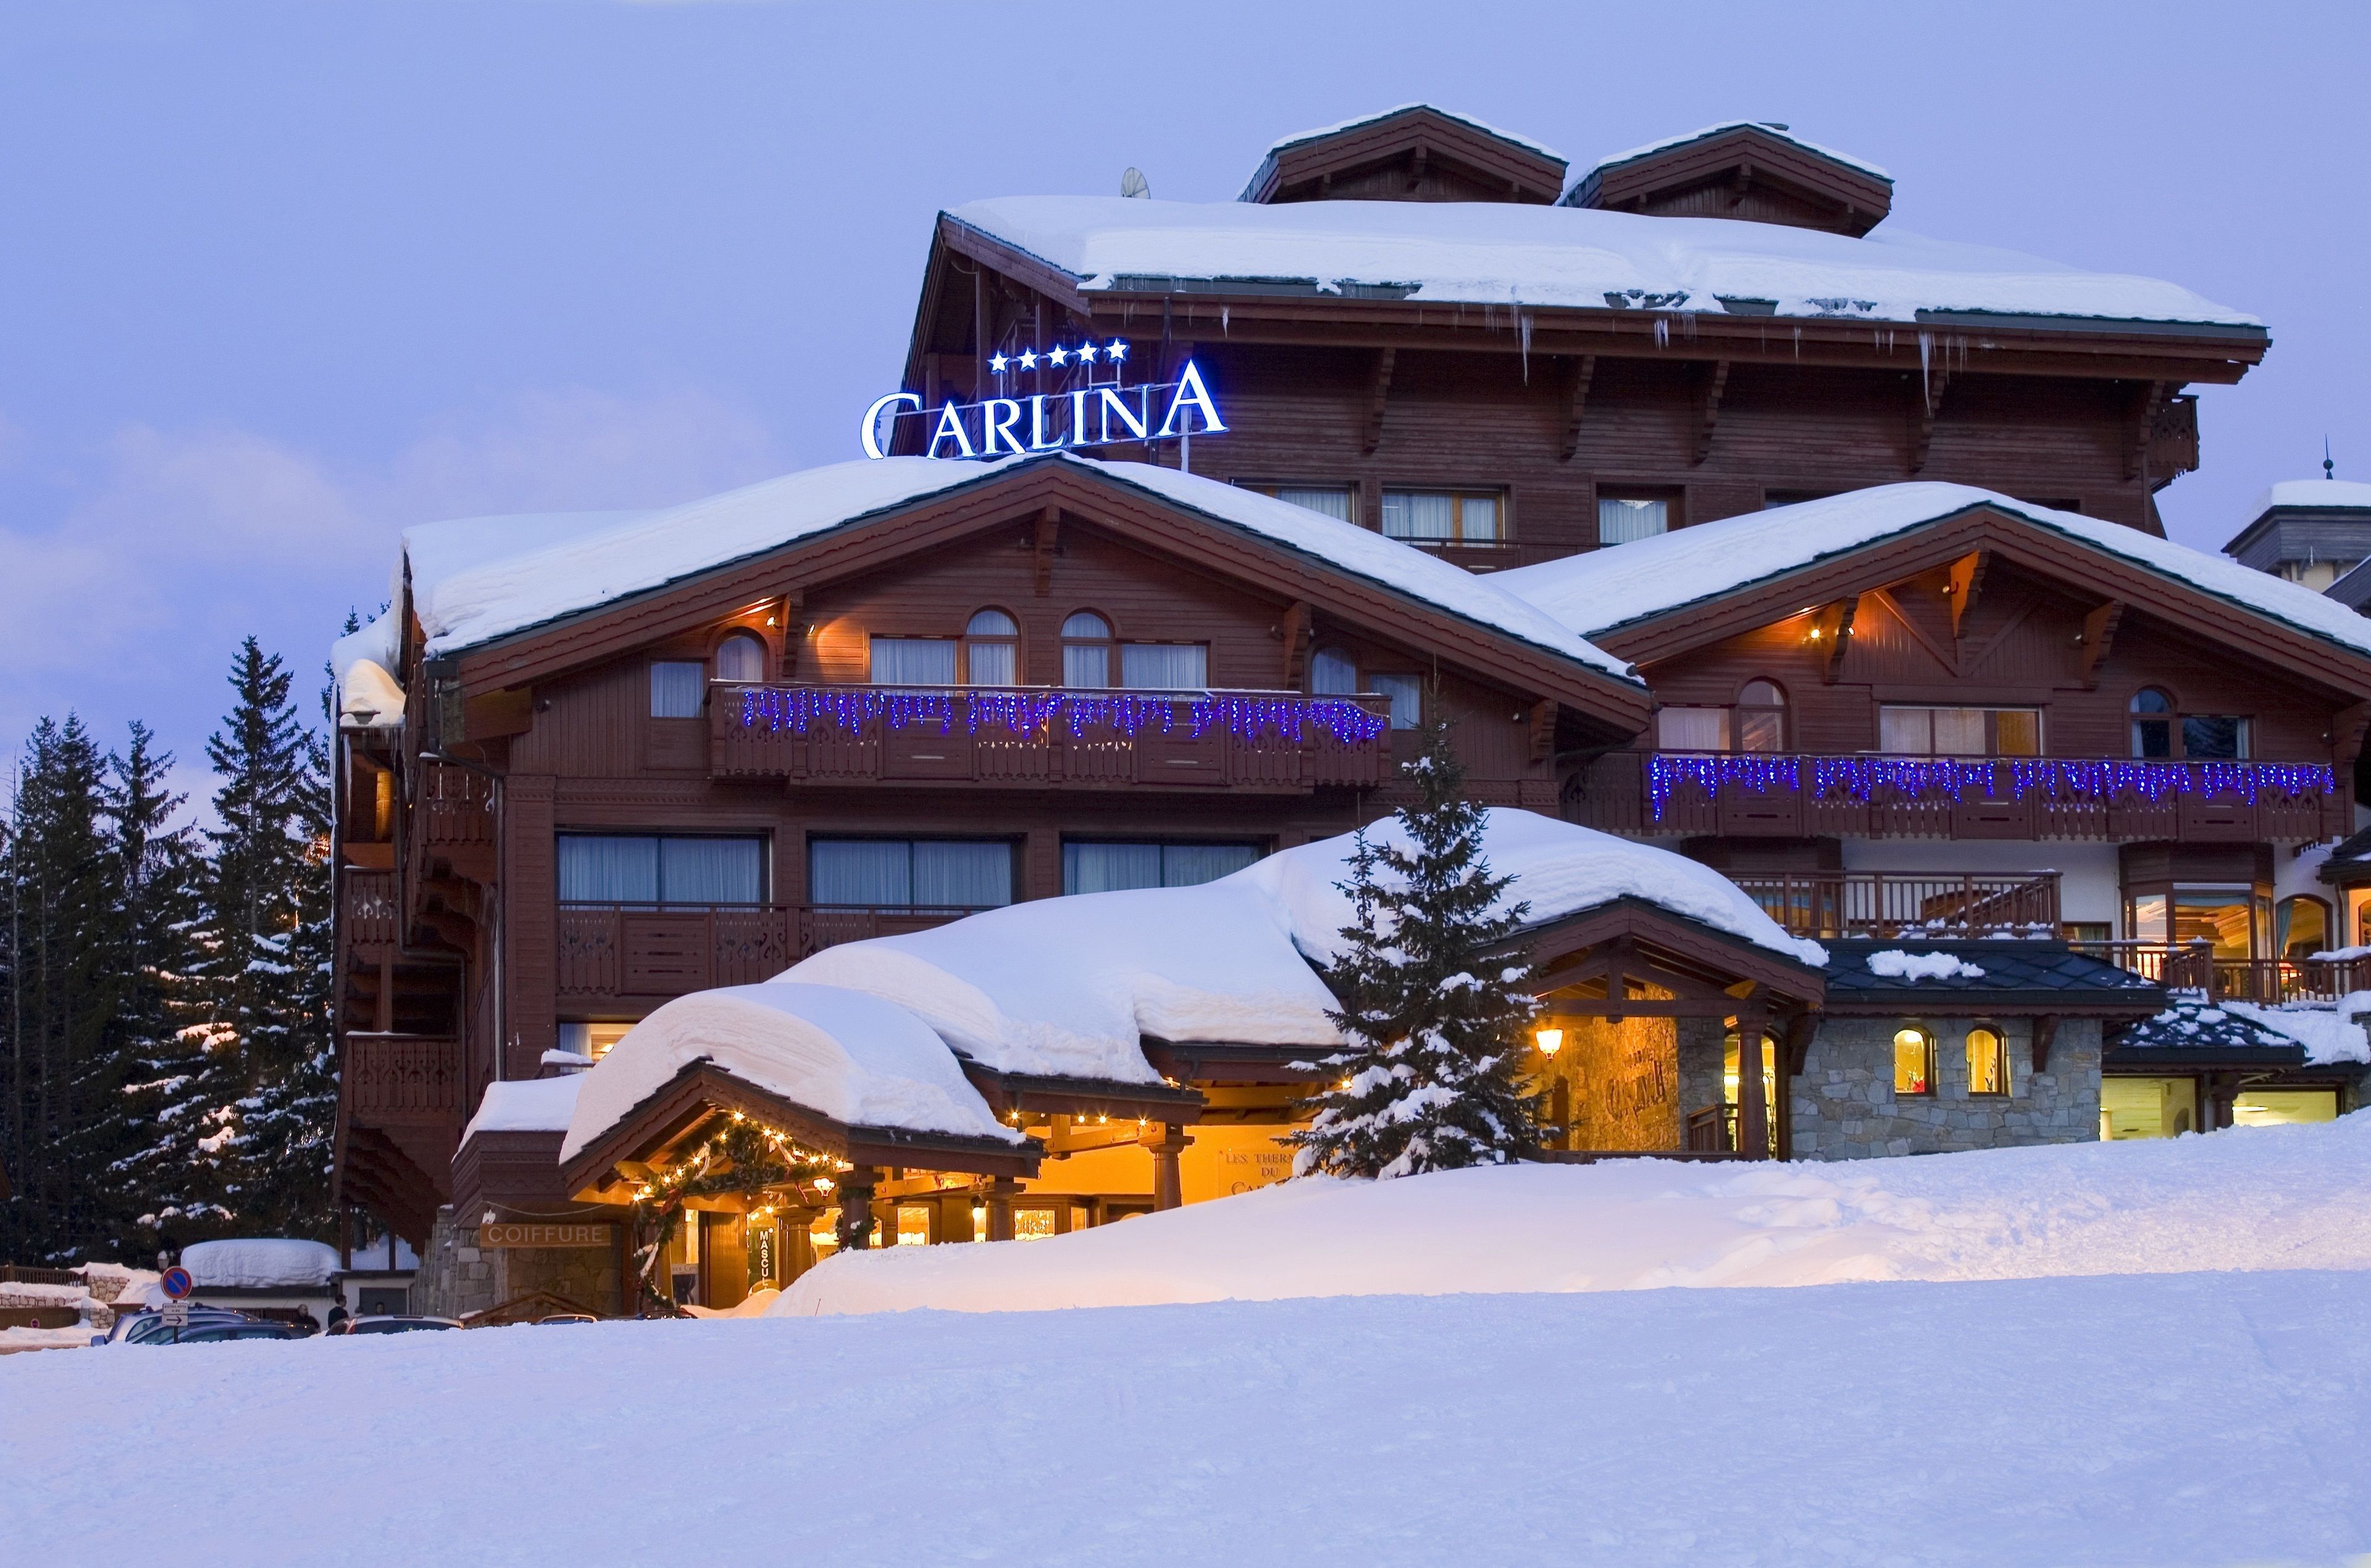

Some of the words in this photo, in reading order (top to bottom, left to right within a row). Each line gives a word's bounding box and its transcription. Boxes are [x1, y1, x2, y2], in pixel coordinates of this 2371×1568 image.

[860, 359, 1229, 460] CARLINA
[1225, 1154, 1247, 1164] LES
[1261, 1167, 1279, 1177] DU
[488, 1226, 603, 1243] COIFFURE
[759, 1230, 769, 1290] MASCUL
